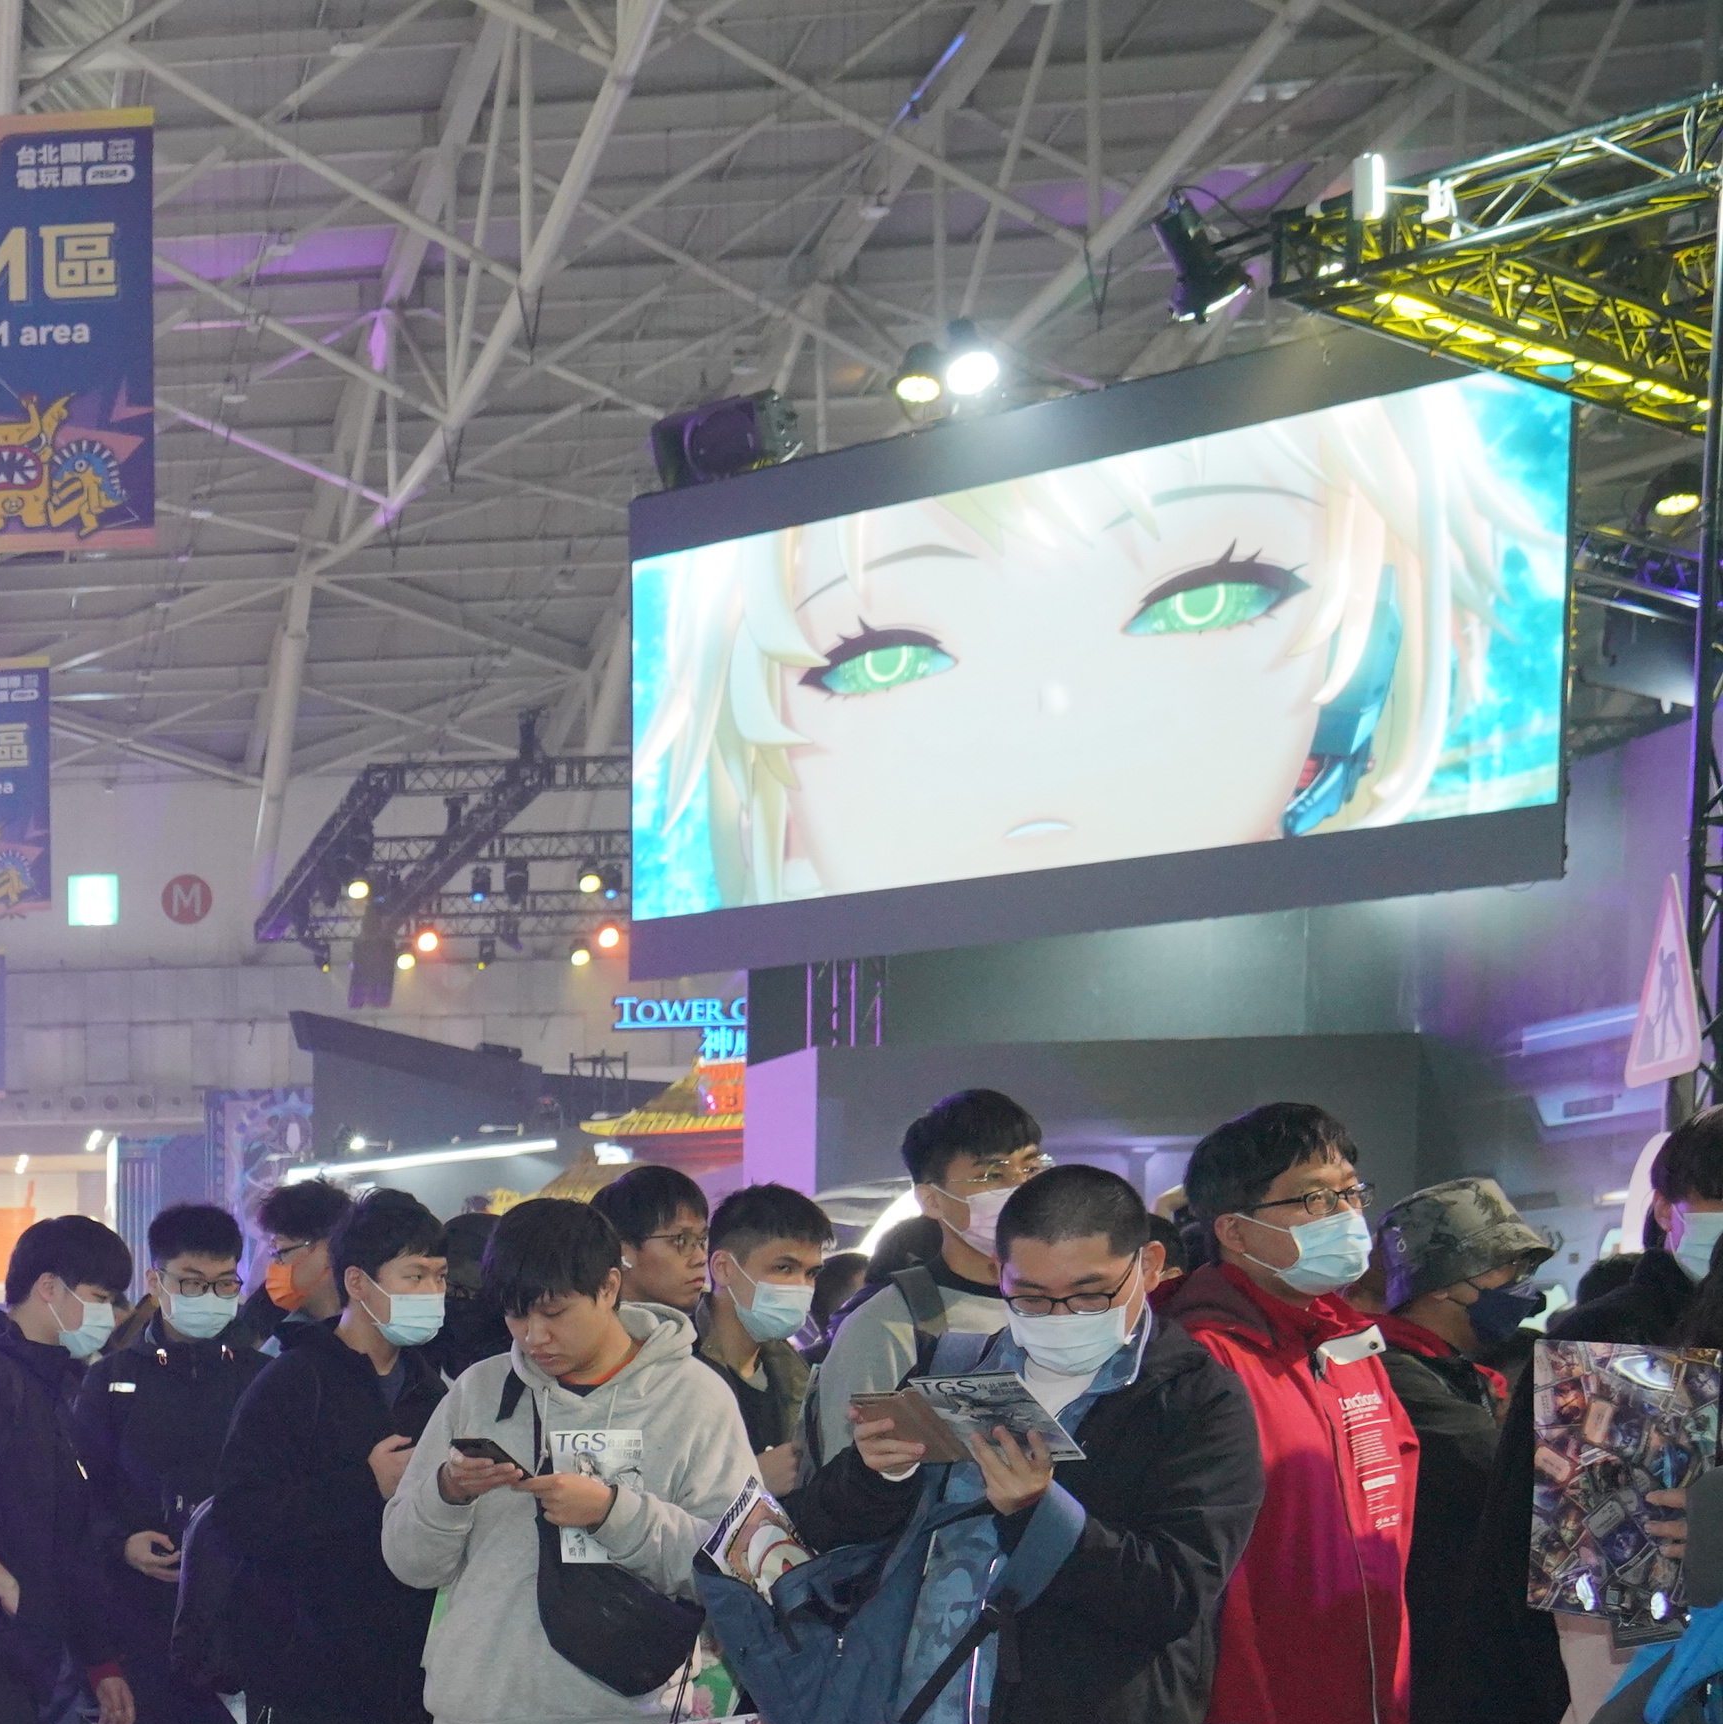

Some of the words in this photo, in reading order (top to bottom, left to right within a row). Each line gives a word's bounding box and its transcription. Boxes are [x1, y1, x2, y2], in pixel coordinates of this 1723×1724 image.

[19, 321, 90, 346] area
[614, 997, 724, 1023] TOWER
[915, 1379, 978, 1396] TGS
[555, 1432, 606, 1452] TGS
